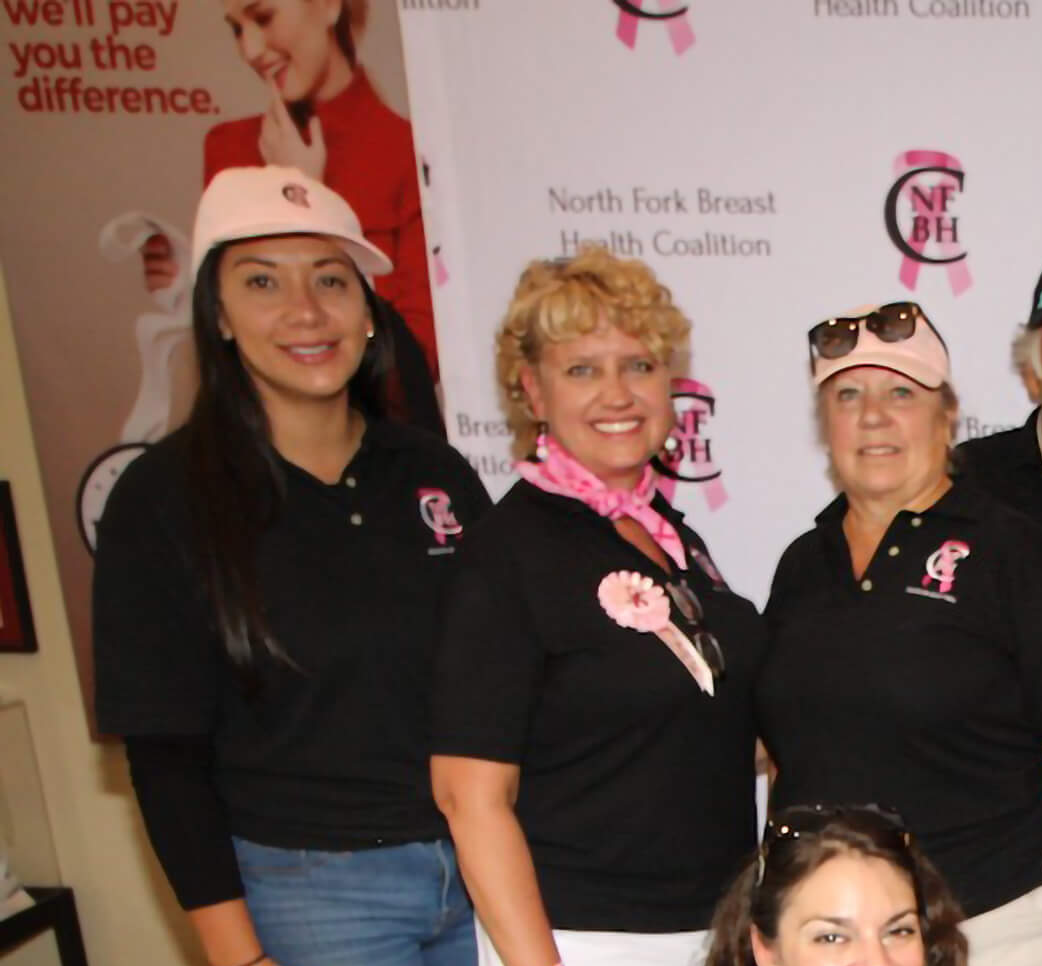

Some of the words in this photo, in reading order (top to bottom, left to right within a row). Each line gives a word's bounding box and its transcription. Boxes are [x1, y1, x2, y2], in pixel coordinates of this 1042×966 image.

[109, 0, 178, 36] pay
[8, 42, 82, 78] you
[90, 34, 156, 71] the
[17, 76, 220, 115] difference.
[547, 186, 623, 215] North
[632, 187, 688, 214] Fork
[697, 188, 777, 215] Breast
[560, 230, 644, 257] Halth
[653, 229, 772, 257] Coalition
